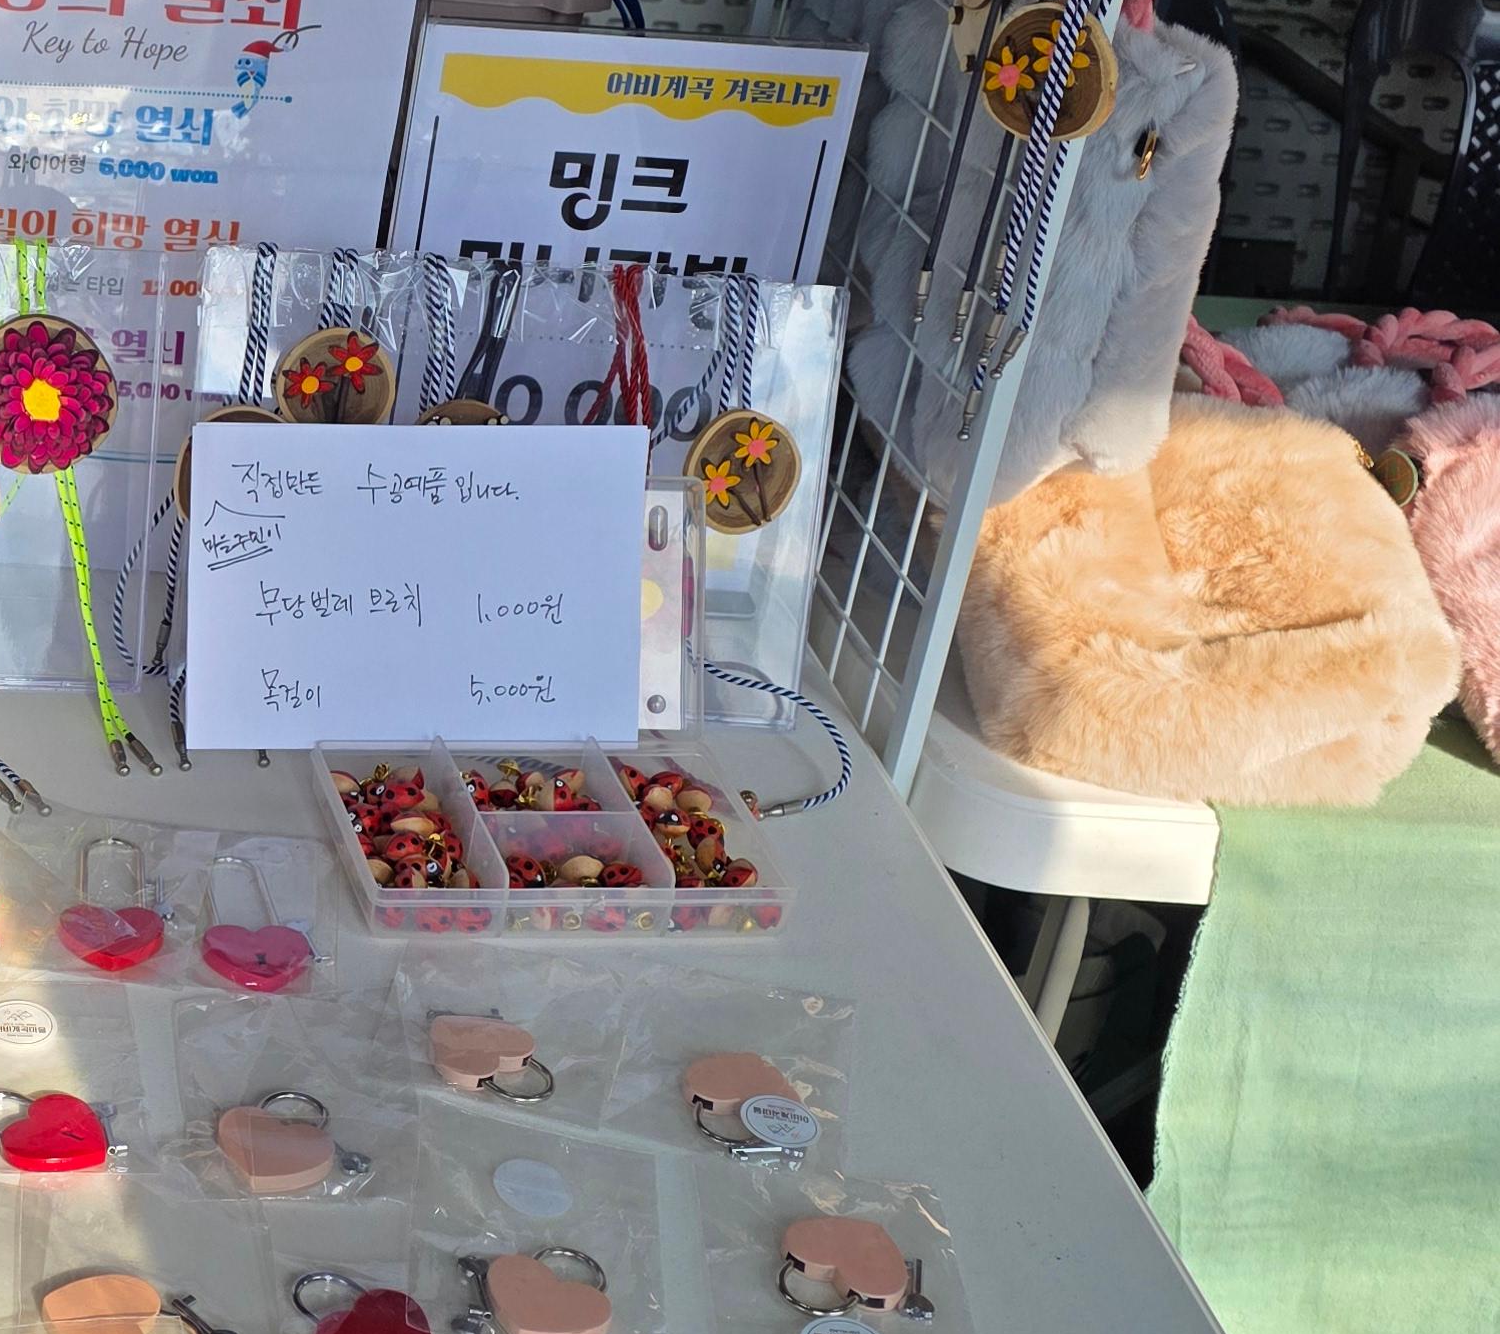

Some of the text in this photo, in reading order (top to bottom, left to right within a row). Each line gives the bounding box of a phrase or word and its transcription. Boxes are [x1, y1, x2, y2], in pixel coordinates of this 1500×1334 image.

[21, 20, 190, 71] Key to Hope
[606, 71, 832, 109] 어비계곡 겨울나라
[134, 104, 215, 147] 열쇠
[8, 153, 219, 184] 와이어형 6,000 won
[548, 150, 690, 231] 밍크
[86, 275, 124, 296] 타입
[261, 668, 322, 712] 목걸이
